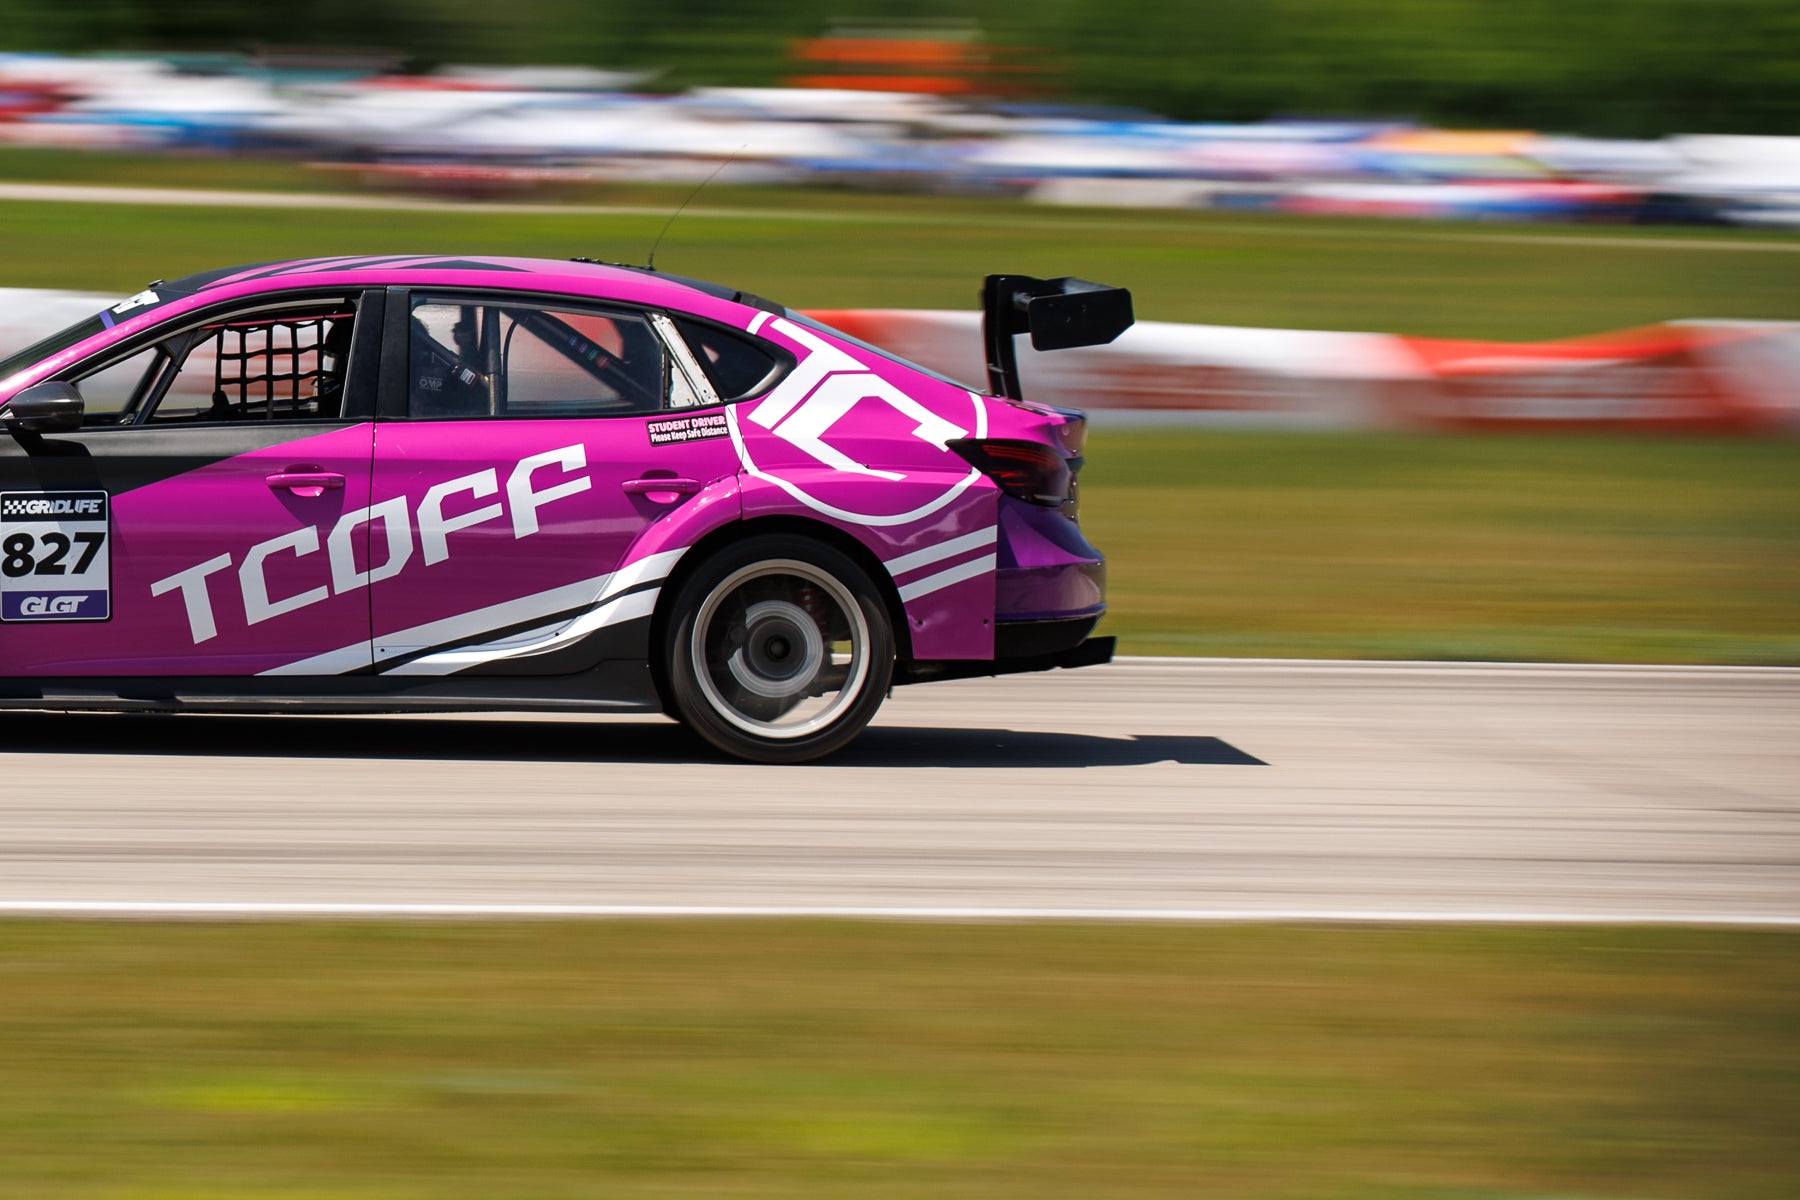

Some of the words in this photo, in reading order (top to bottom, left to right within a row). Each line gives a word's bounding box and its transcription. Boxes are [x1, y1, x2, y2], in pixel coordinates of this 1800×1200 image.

[648, 419, 690, 433] STUDENT
[691, 415, 726, 428] DRIVER
[650, 430, 672, 443] Please
[672, 429, 688, 441] Keep
[687, 428, 702, 439] Safe
[701, 425, 728, 437] Distance
[25, 499, 103, 515] GRIDLIFE
[150, 443, 591, 644] TCOFF
[1, 531, 106, 578] 827
[20, 595, 89, 616] GLGT
